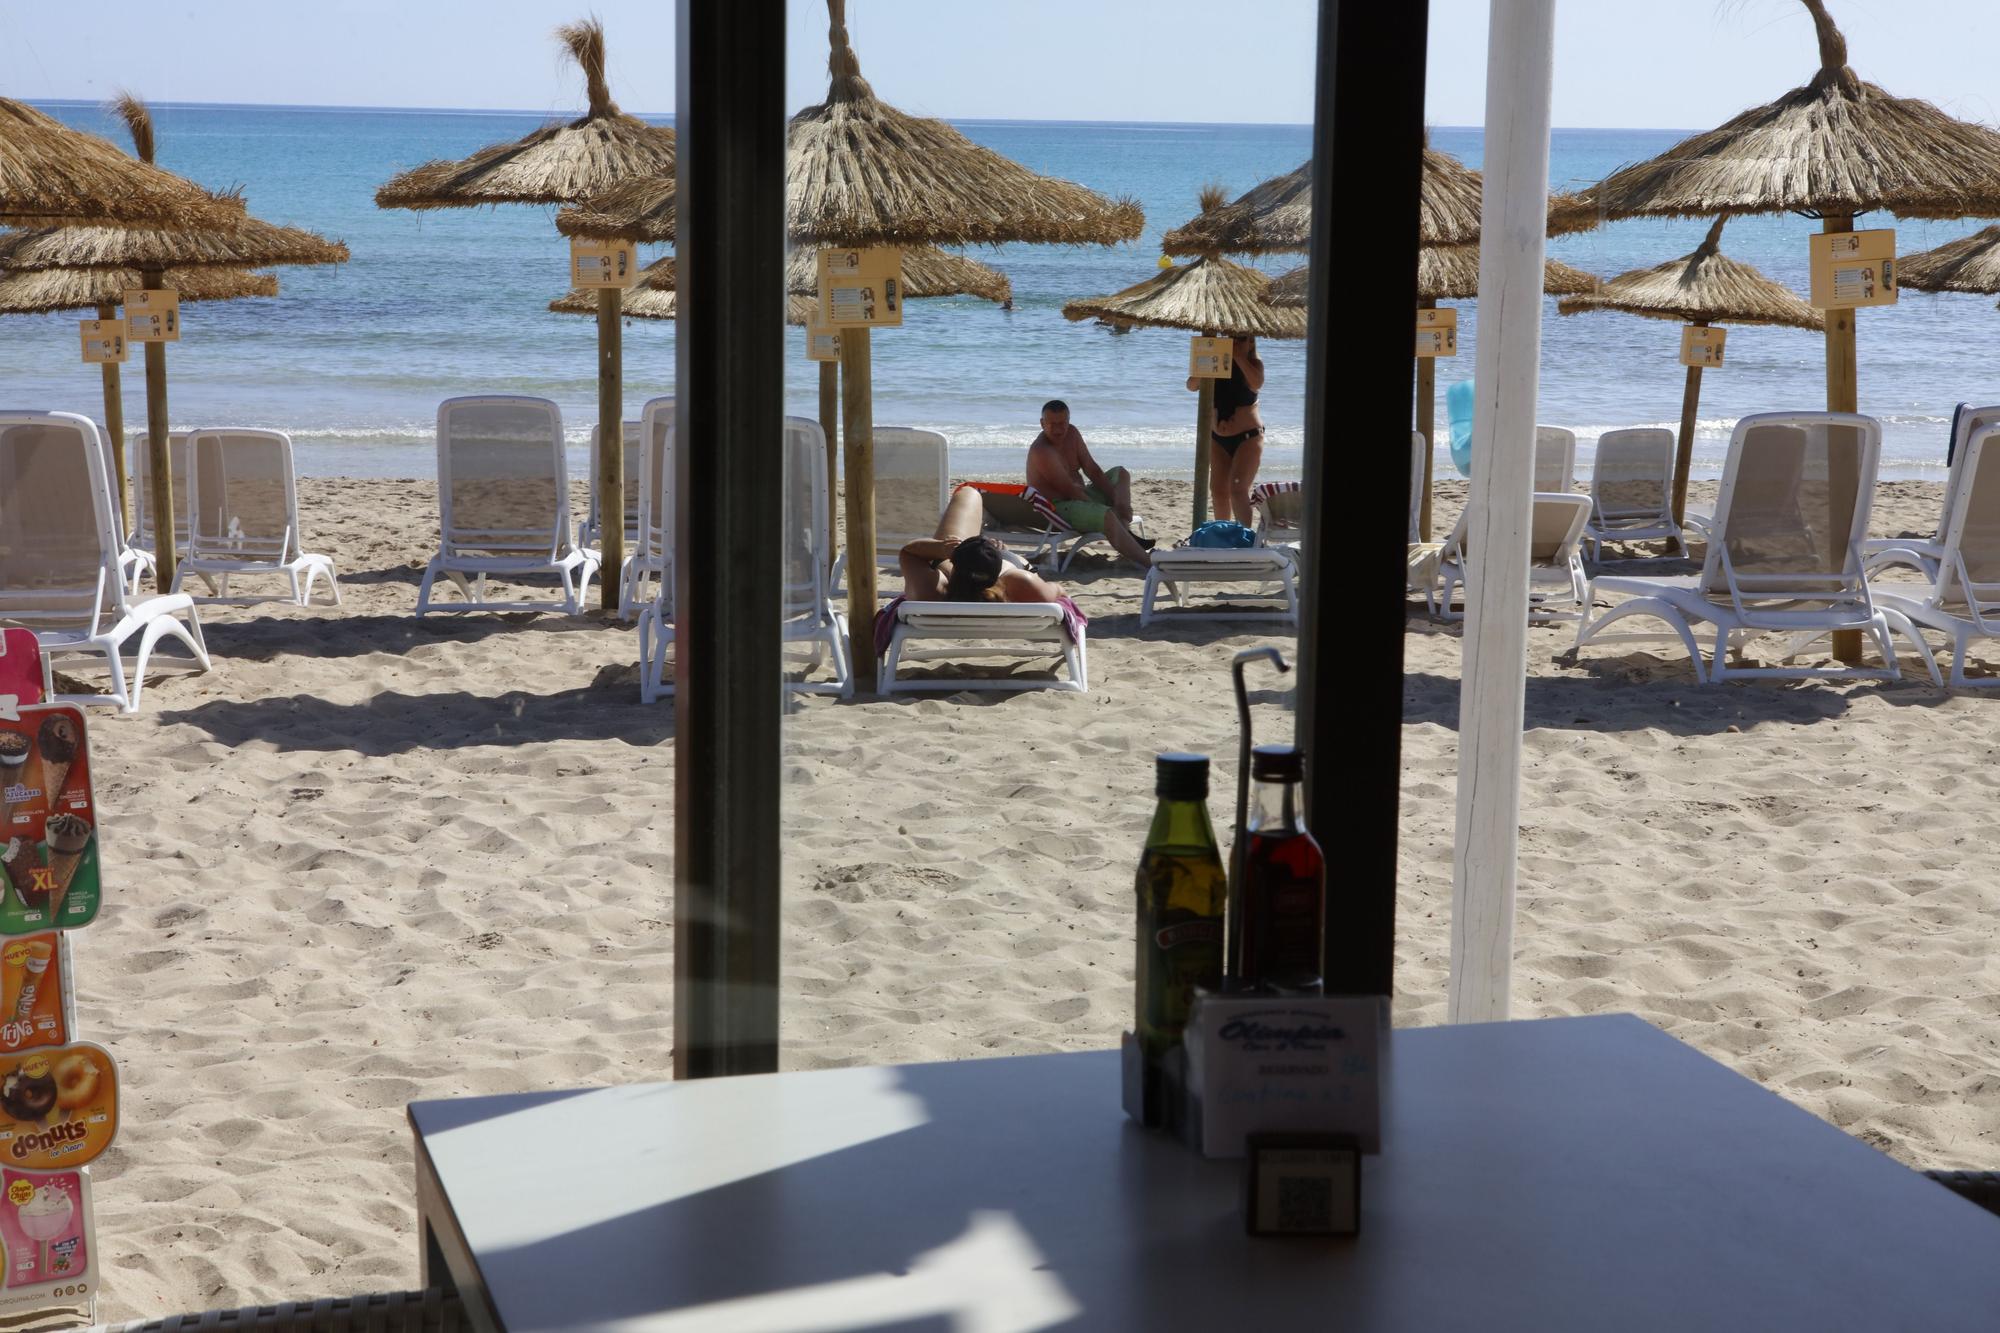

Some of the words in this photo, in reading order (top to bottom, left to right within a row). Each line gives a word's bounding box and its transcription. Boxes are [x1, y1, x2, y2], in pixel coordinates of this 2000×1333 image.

[6, 790, 40, 798] AZUCARES
[32, 872, 58, 891] XL
[4, 947, 31, 960] NUEVO
[23, 1060, 49, 1072] NUEVO
[1258, 1065, 1329, 1076] RESERVADO
[12, 1121, 87, 1158] donuts
